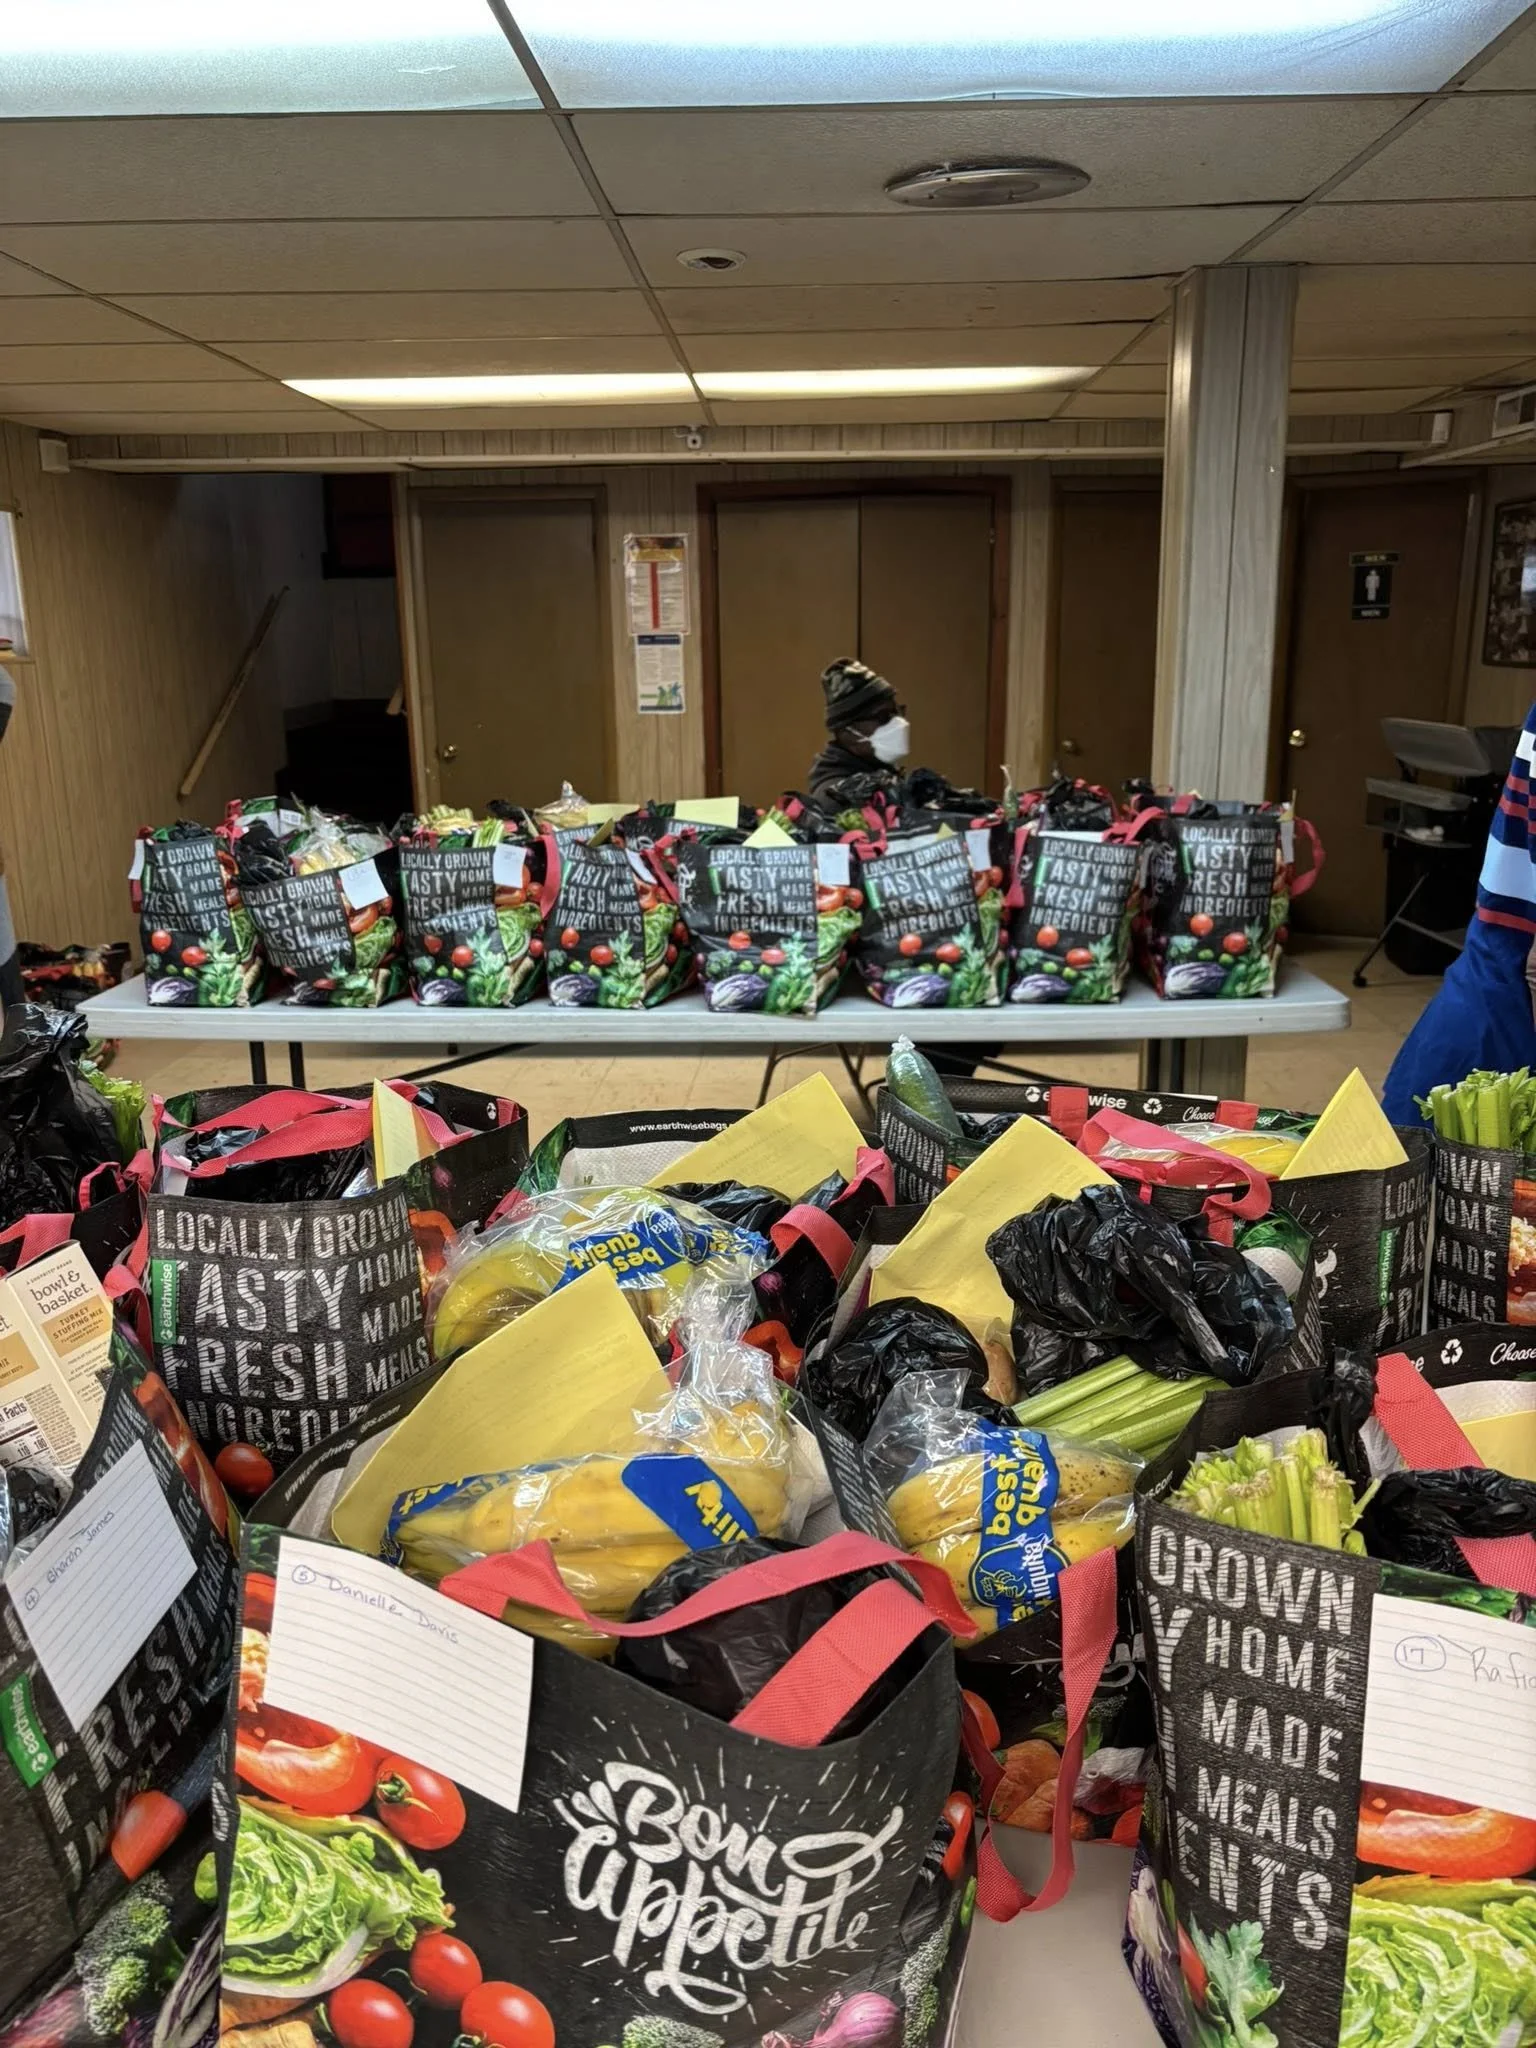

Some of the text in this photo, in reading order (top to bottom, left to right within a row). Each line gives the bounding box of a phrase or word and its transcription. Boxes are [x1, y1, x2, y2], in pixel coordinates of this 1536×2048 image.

[166, 843, 216, 864] GROWN
[184, 860, 220, 877] HOME
[764, 849, 810, 865] GROWN
[1042, 839, 1094, 860] LOCALLY
[253, 900, 305, 929] ASTY
[1029, 906, 1119, 936] INGREDIENT
[1182, 1106, 1215, 1122] Choose
[1437, 1149, 1501, 1198] OWN
[156, 1194, 412, 1260] LOCALLY GROWN
[30, 1269, 81, 1302] bowl &
[357, 1240, 420, 1294] HOME
[611, 1246, 666, 1279] bes
[59, 1306, 90, 1326] TURKEY
[161, 1263, 173, 1328] earthwise
[362, 1287, 424, 1344] MADE
[52, 1307, 104, 1340] STUFFING MIX
[162, 1335, 350, 1401] FRESH
[365, 1336, 430, 1396] MEALS
[3, 1401, 28, 1420] Facts
[985, 1453, 1020, 1537] best
[1149, 1525, 1355, 1635] GROWN
[327, 1575, 402, 1617] Danielle
[416, 1609, 459, 1645] Davis
[1205, 1615, 1349, 1706] HOME
[1201, 1690, 1344, 1783] MADE
[603, 1760, 785, 1897] Bon
[1197, 1765, 1337, 1861] MEALS
